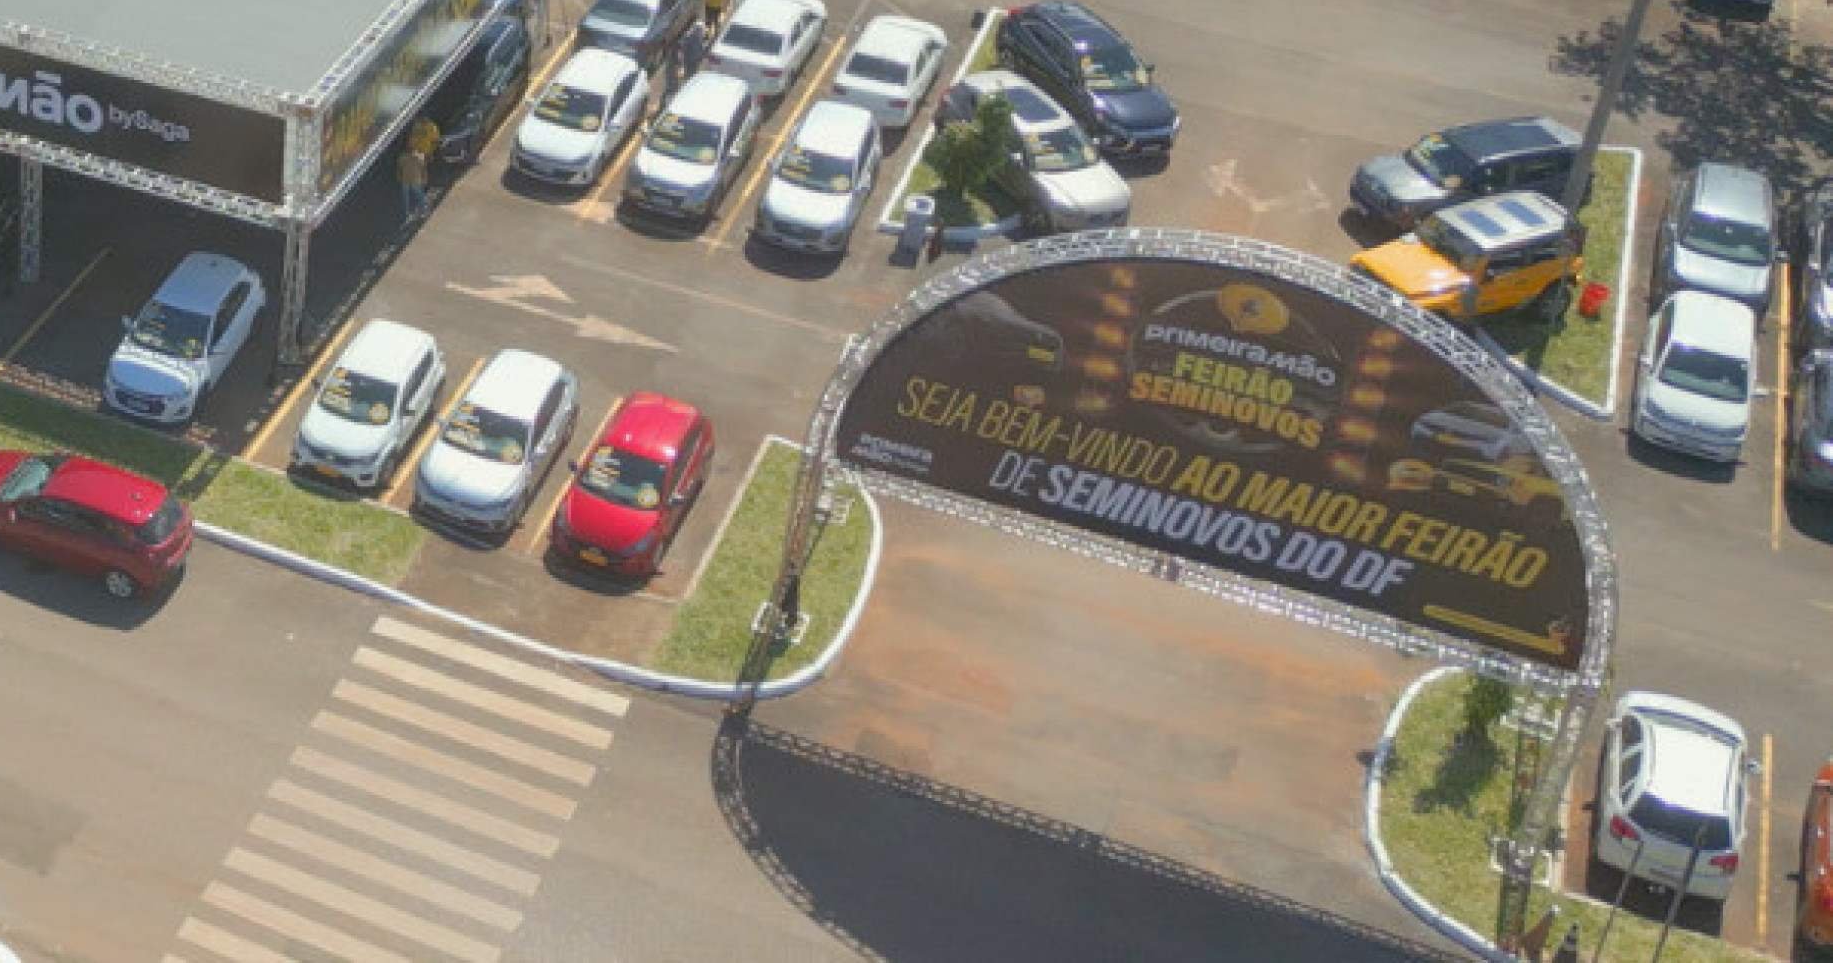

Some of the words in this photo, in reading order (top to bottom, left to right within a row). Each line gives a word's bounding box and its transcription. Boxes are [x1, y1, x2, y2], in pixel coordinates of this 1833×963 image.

[1130, 371, 1323, 449] SEMINOVOS
[1174, 351, 1293, 404] FEIRÃO
[897, 378, 978, 432] SEJA
[977, 399, 1179, 484] BEM-VINDO
[1170, 455, 1241, 503] AO
[1236, 471, 1389, 546] MAIOR
[1382, 511, 1550, 588] FEIRÃO
[989, 449, 1045, 496] DE
[1038, 464, 1281, 562] SEMINOVOS
[1276, 534, 1348, 581] DO
[1340, 550, 1415, 597] DF
